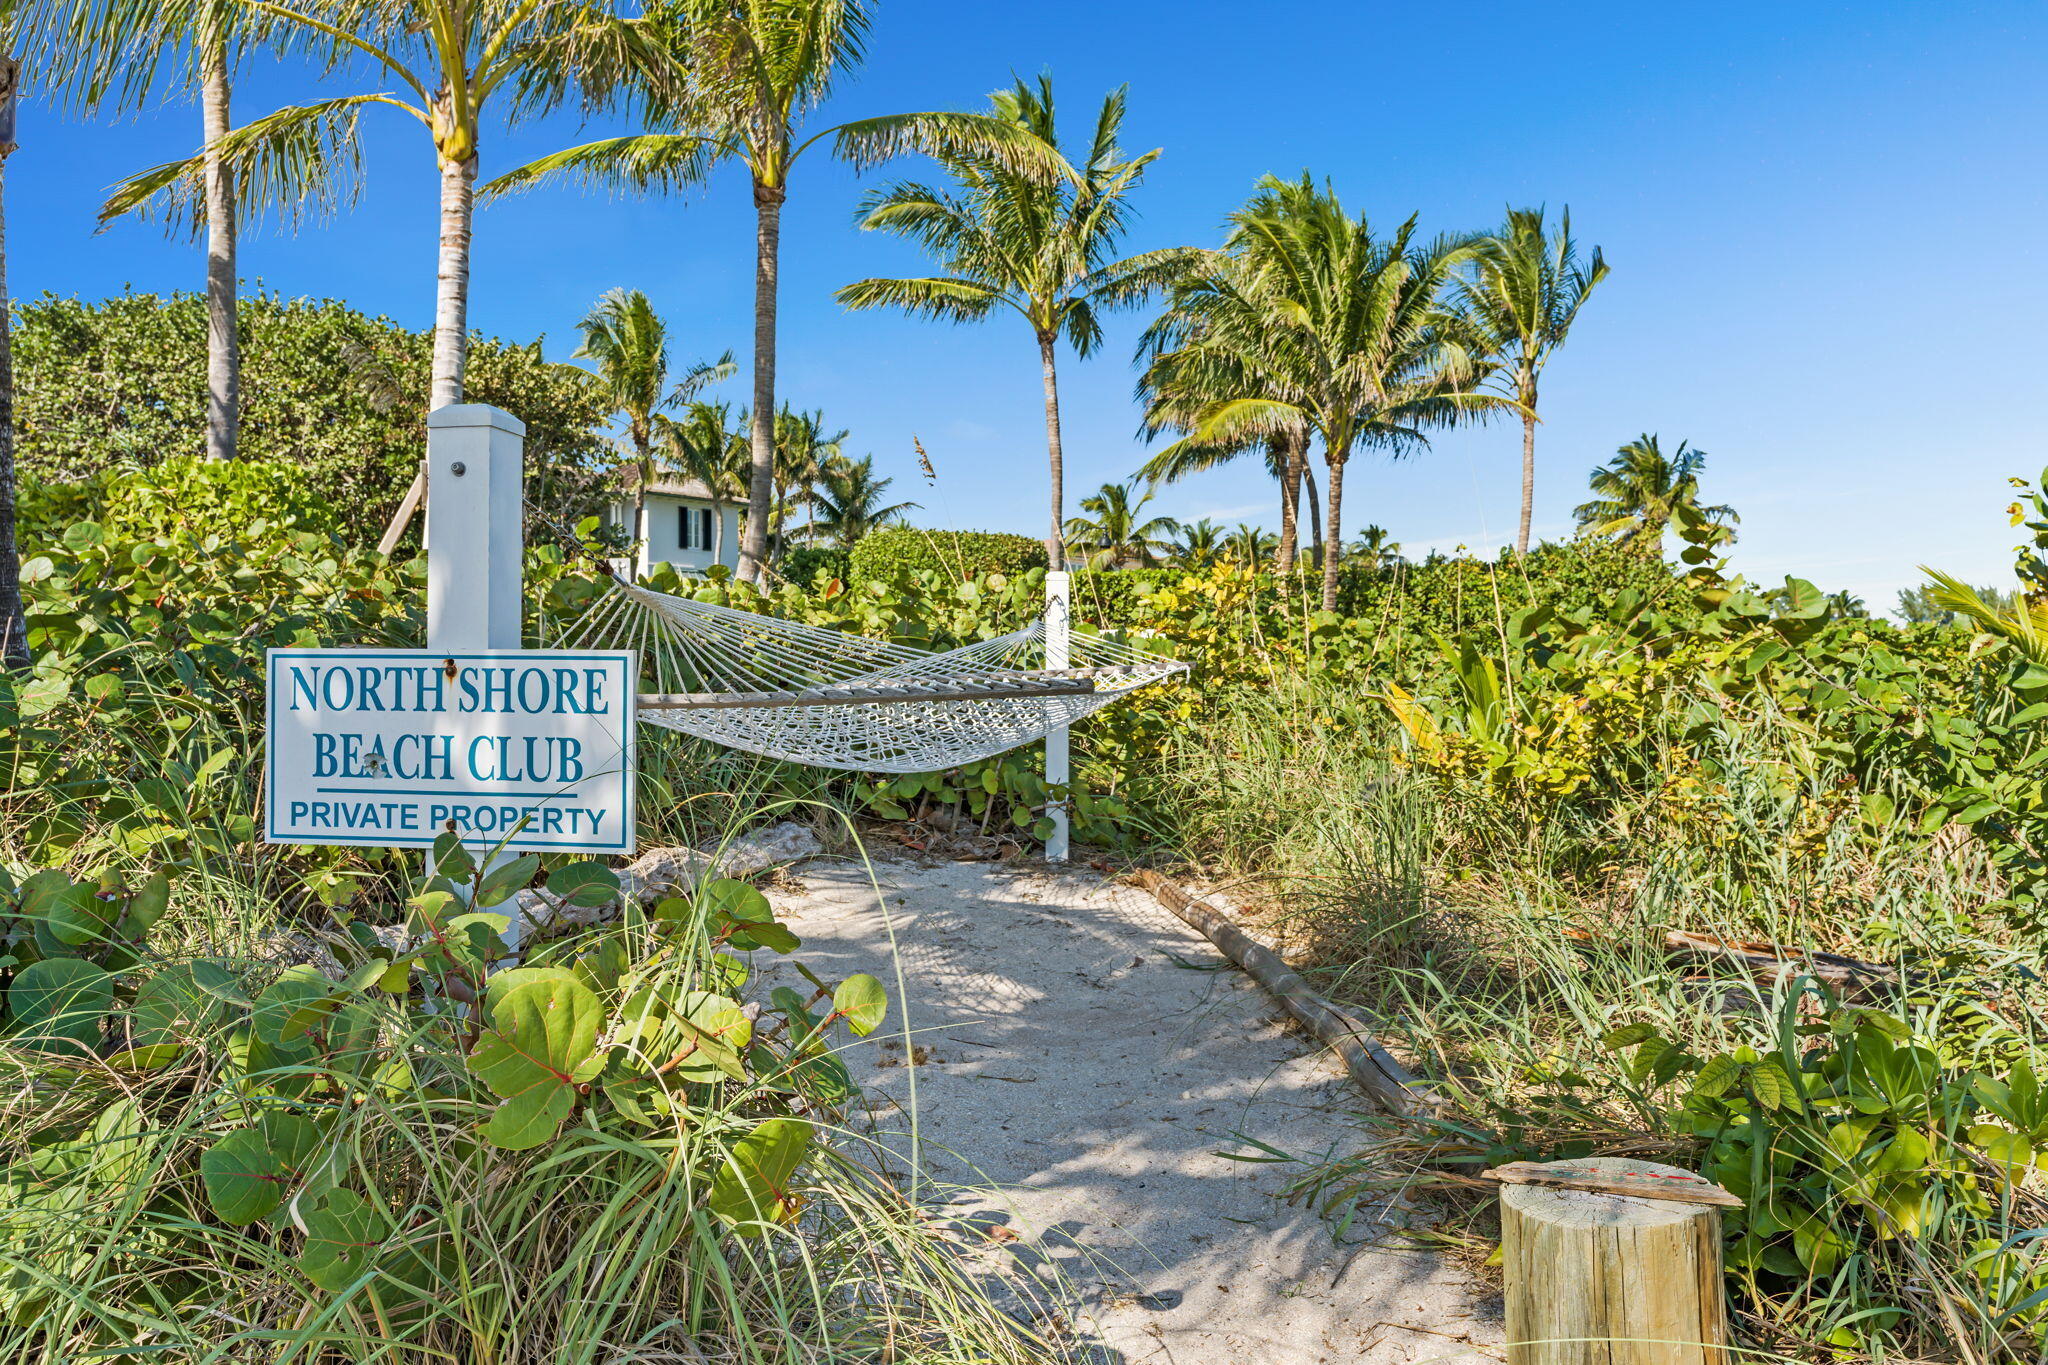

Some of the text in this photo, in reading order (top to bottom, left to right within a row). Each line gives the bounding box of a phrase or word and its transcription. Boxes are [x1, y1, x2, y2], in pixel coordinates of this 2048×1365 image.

[289, 666, 609, 715] NORTH SHORE
[312, 733, 583, 783] BEACH CLUB
[290, 801, 607, 835] PRIVATE PROPERTY
